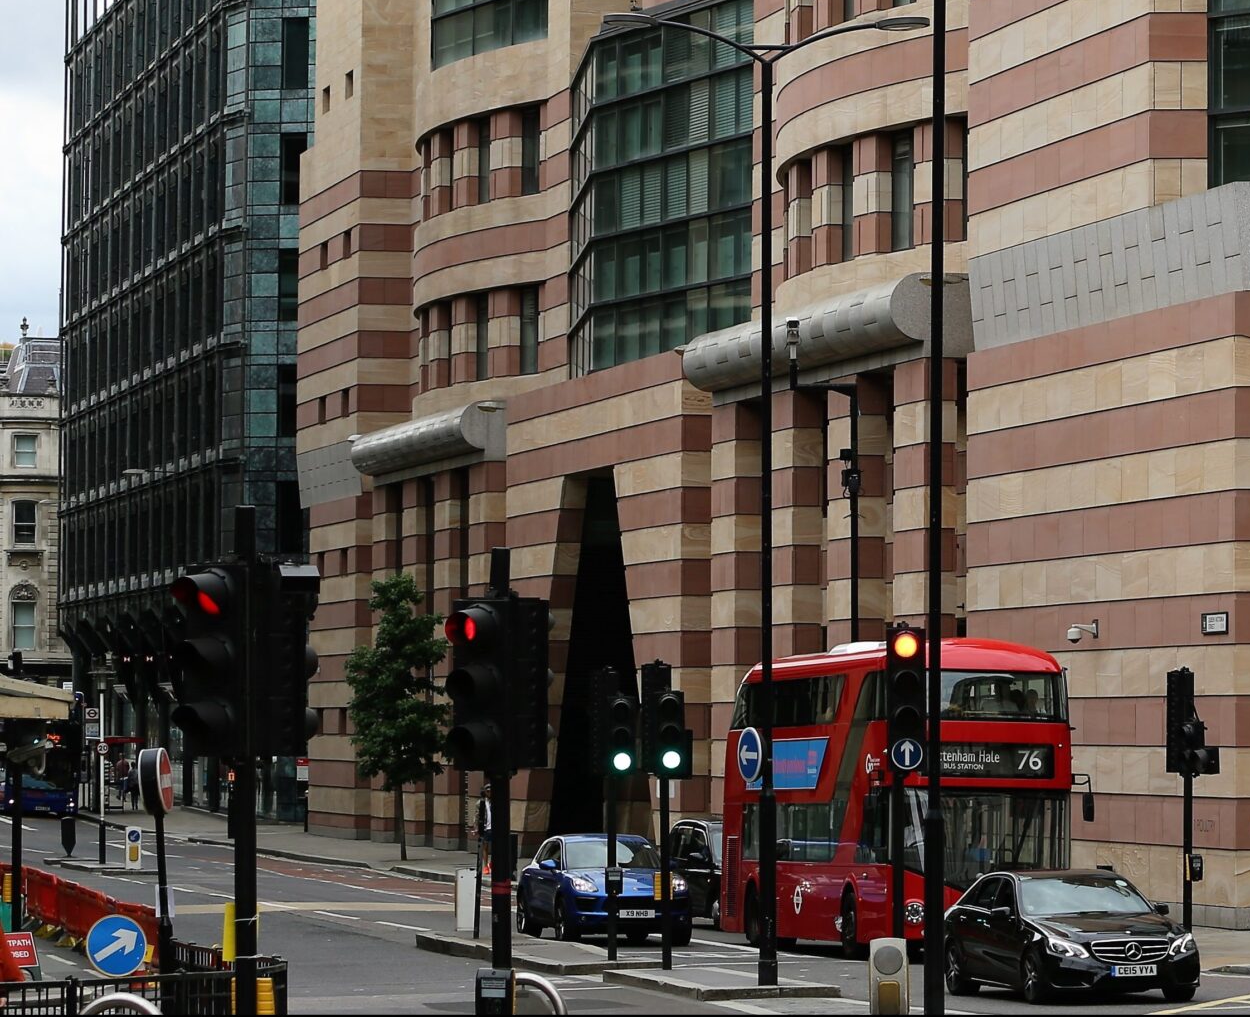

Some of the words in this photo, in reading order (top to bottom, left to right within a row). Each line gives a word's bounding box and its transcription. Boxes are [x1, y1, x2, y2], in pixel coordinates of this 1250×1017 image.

[940, 750, 976, 763] tenham
[978, 750, 1000, 763] Hale
[1017, 749, 1042, 771] 76
[7, 939, 31, 947] TPATH
[1139, 966, 1154, 975] VYA
